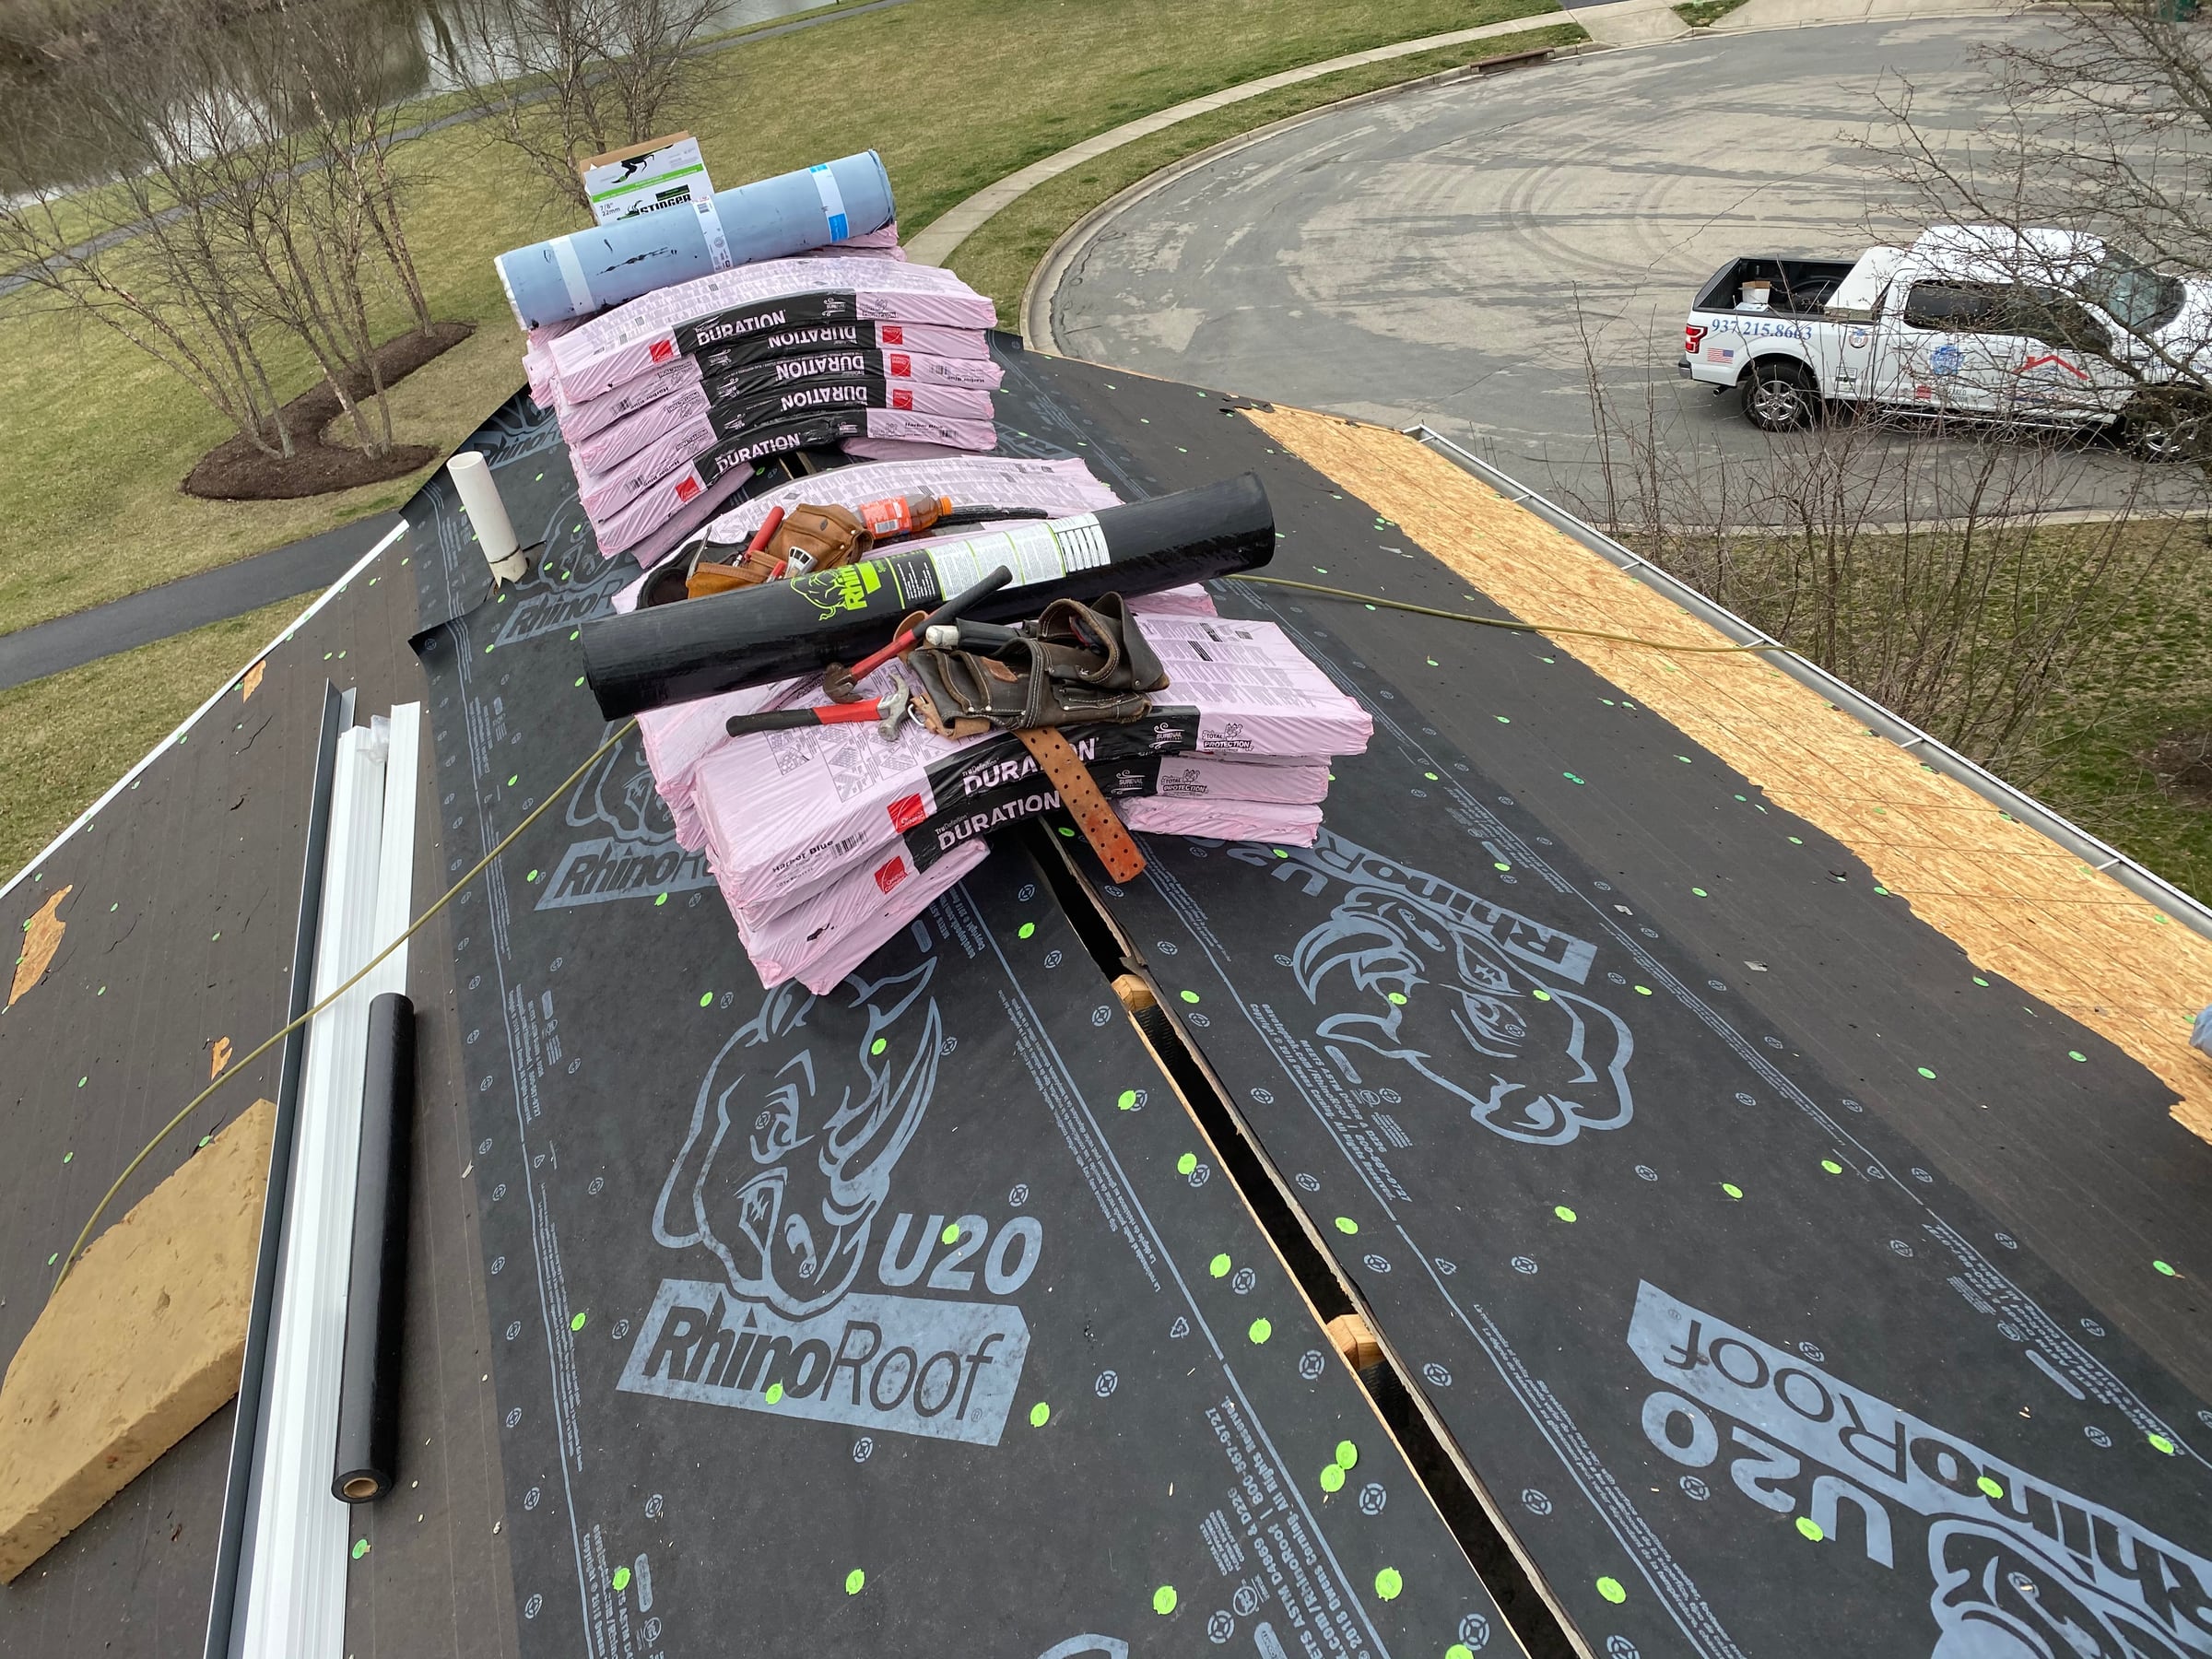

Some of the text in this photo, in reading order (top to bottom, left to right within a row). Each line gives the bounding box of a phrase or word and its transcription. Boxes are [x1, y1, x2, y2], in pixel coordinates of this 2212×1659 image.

[602, 206, 620, 218] 22mm
[640, 193, 692, 214] STINGER
[696, 309, 786, 347] DURATION
[768, 326, 857, 349] DURATION
[1711, 318, 1813, 341] 937.215.8663
[775, 355, 865, 382] DURATION
[781, 386, 867, 412] DURATION
[715, 432, 802, 474] DURATION
[505, 578, 624, 639] RhinoR
[1204, 740, 1251, 749] PROTECTION
[1163, 784, 1207, 794] PROTECTION
[937, 790, 1061, 851] DURATION
[809, 840, 834, 856] Blue
[1315, 835, 1571, 965] RhinoR
[1250, 1004, 1277, 1035] Copyright
[1293, 1065, 1312, 1087] Owens
[1334, 1122, 1347, 1131] All
[1300, 1041, 1324, 1065] MEETS
[1321, 1068, 1343, 1091] ASTM
[1356, 1132, 1412, 1202] 800-567-9727
[877, 1212, 1043, 1295] U20
[642, 1303, 1005, 1421] RhinoRoof
[1221, 1396, 1255, 1453] Reserved.
[1206, 1408, 1263, 1504] 800-567-9727
[1253, 1453, 1277, 1493] Rights
[1641, 1391, 1894, 1569] U20
[1228, 1488, 1252, 1524] D226
[1273, 1492, 1288, 1511] All
[1248, 1523, 1257, 1535] &
[1288, 1512, 1316, 1565] Corning.
[1254, 1538, 1282, 1585] D4869
[1278, 1585, 1305, 1627] ASTM
[1314, 1565, 1340, 1611] Owens
[1336, 1611, 1362, 1649] 2018
